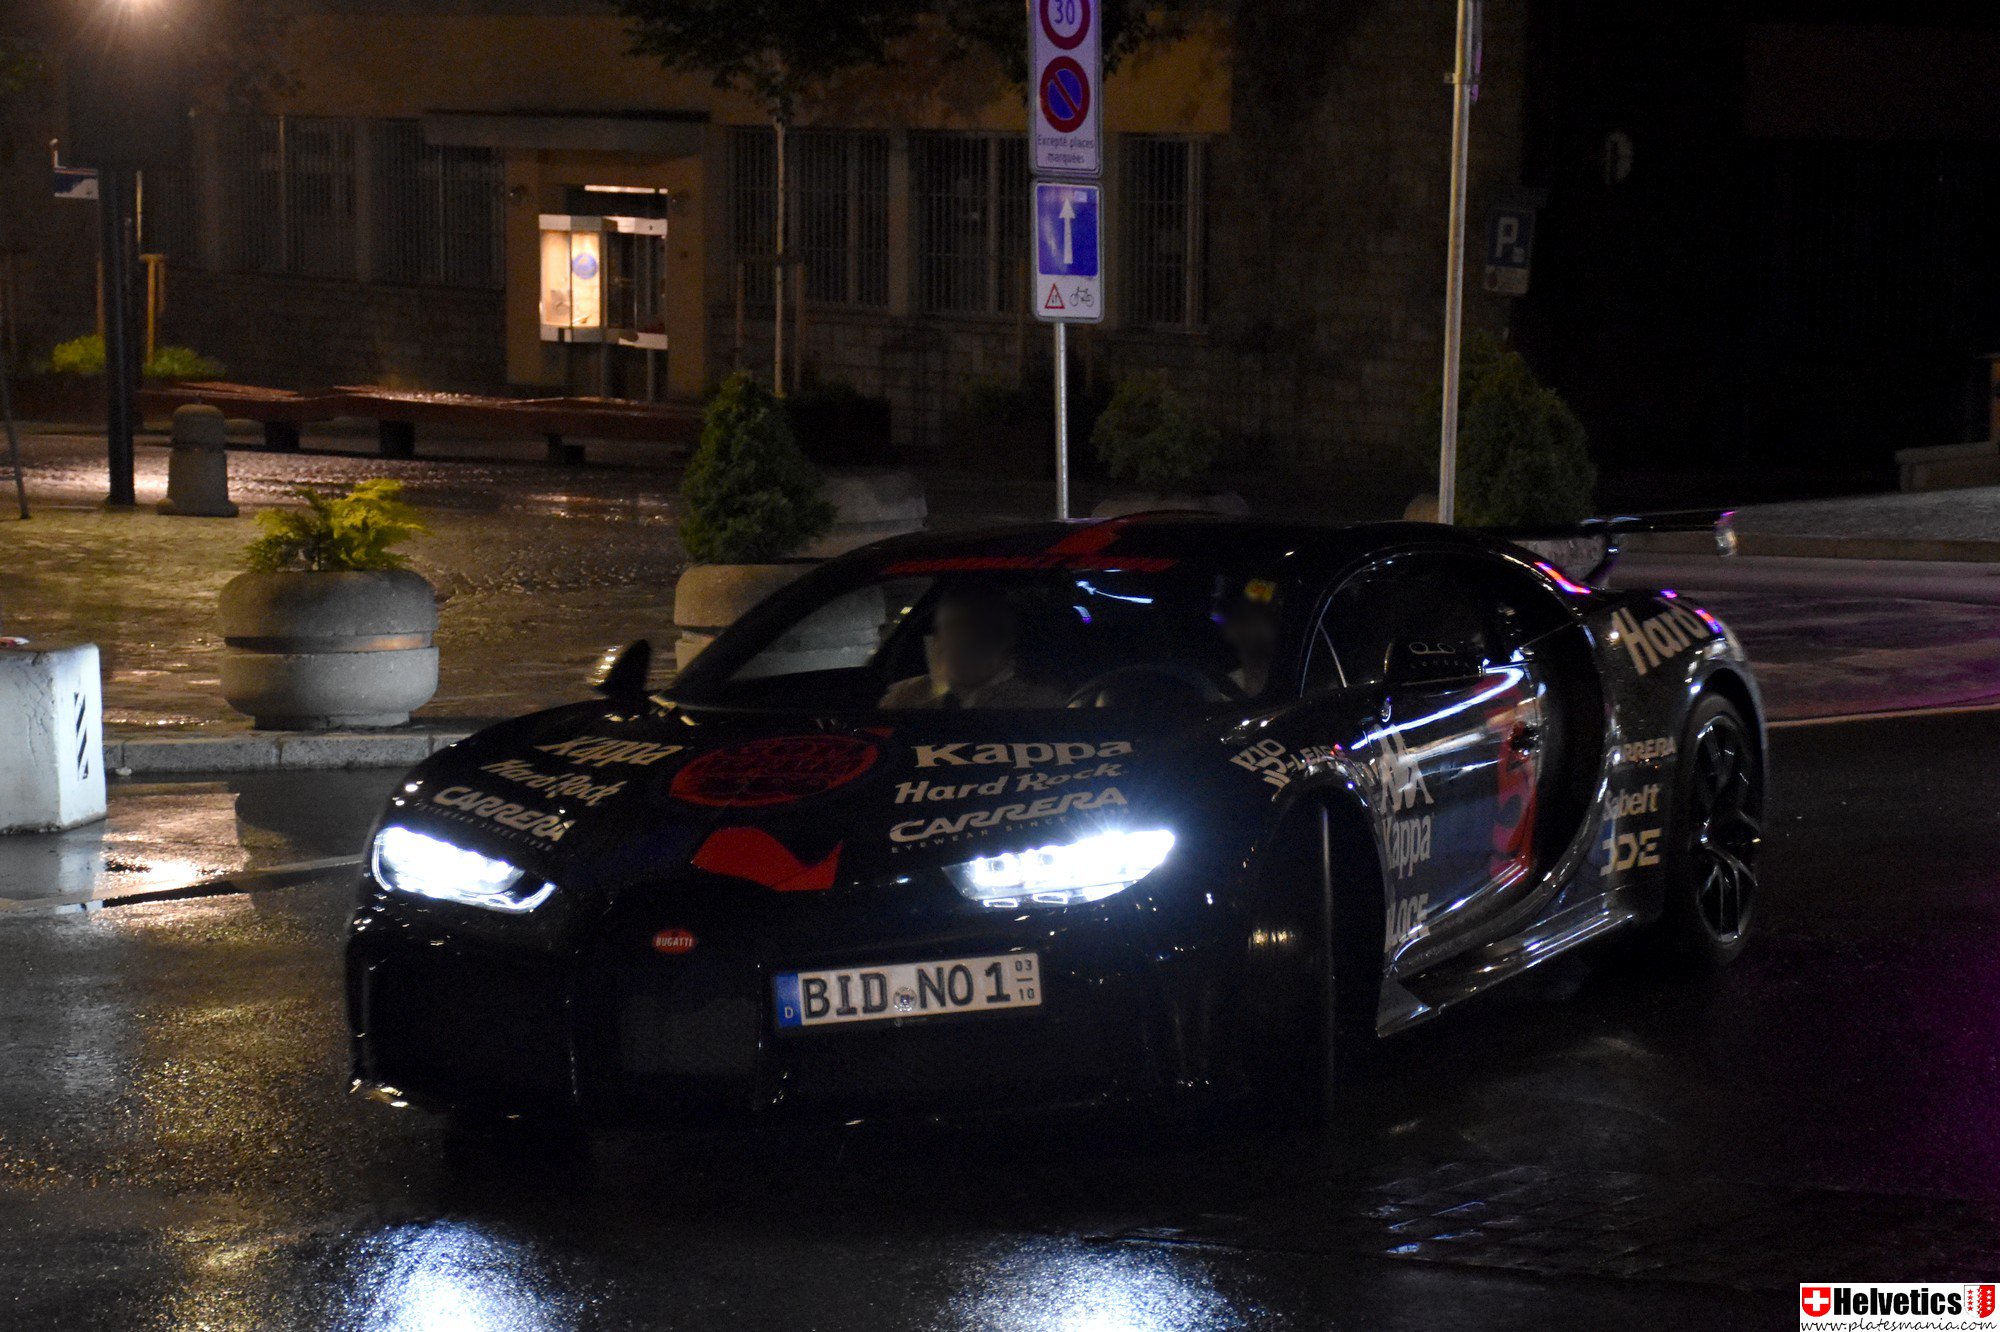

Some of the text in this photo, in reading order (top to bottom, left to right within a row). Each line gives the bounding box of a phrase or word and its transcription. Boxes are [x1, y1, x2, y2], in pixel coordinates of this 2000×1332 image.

[1054, 0, 1075, 25] 30
[1496, 216, 1520, 258] P
[533, 736, 686, 767] Kappa
[911, 740, 1134, 769] Kappa
[894, 763, 1124, 804] Hard Rock
[433, 786, 577, 842] CARRERA
[889, 786, 1128, 843] CARRERA
[656, 936, 693, 947] BUGATTI
[1015, 959, 1032, 972] 03
[801, 972, 888, 1019] BID
[1018, 988, 1035, 1001] 10
